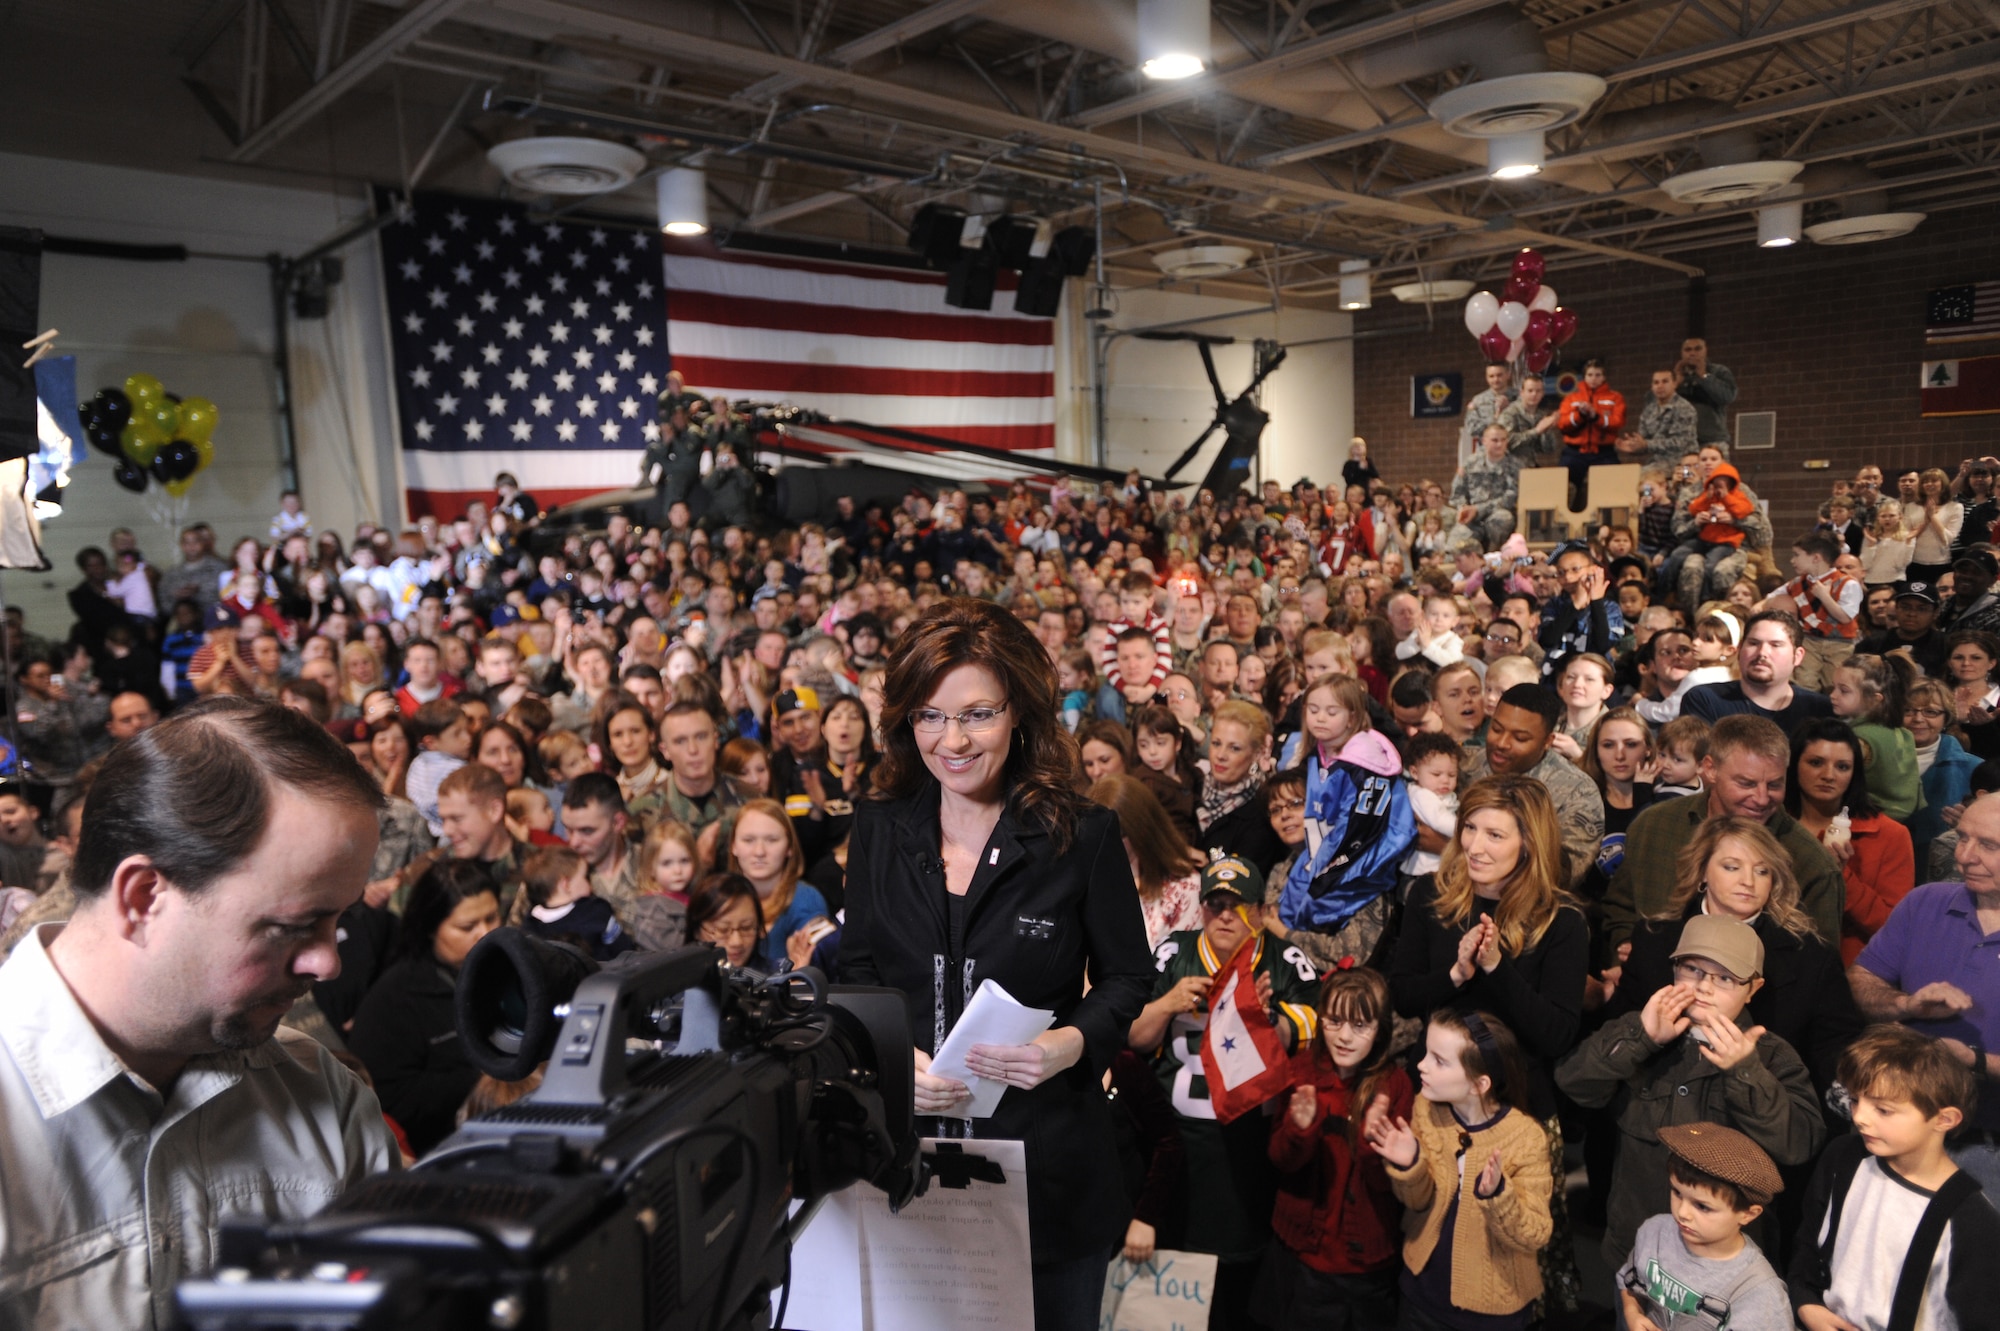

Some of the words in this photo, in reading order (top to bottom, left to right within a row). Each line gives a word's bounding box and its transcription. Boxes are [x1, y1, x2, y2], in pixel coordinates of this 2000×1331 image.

[1944, 307, 1960, 318] 76
[1331, 540, 1345, 569] 7
[1355, 776, 1391, 816] 27
[1147, 1260, 1205, 1304] You
